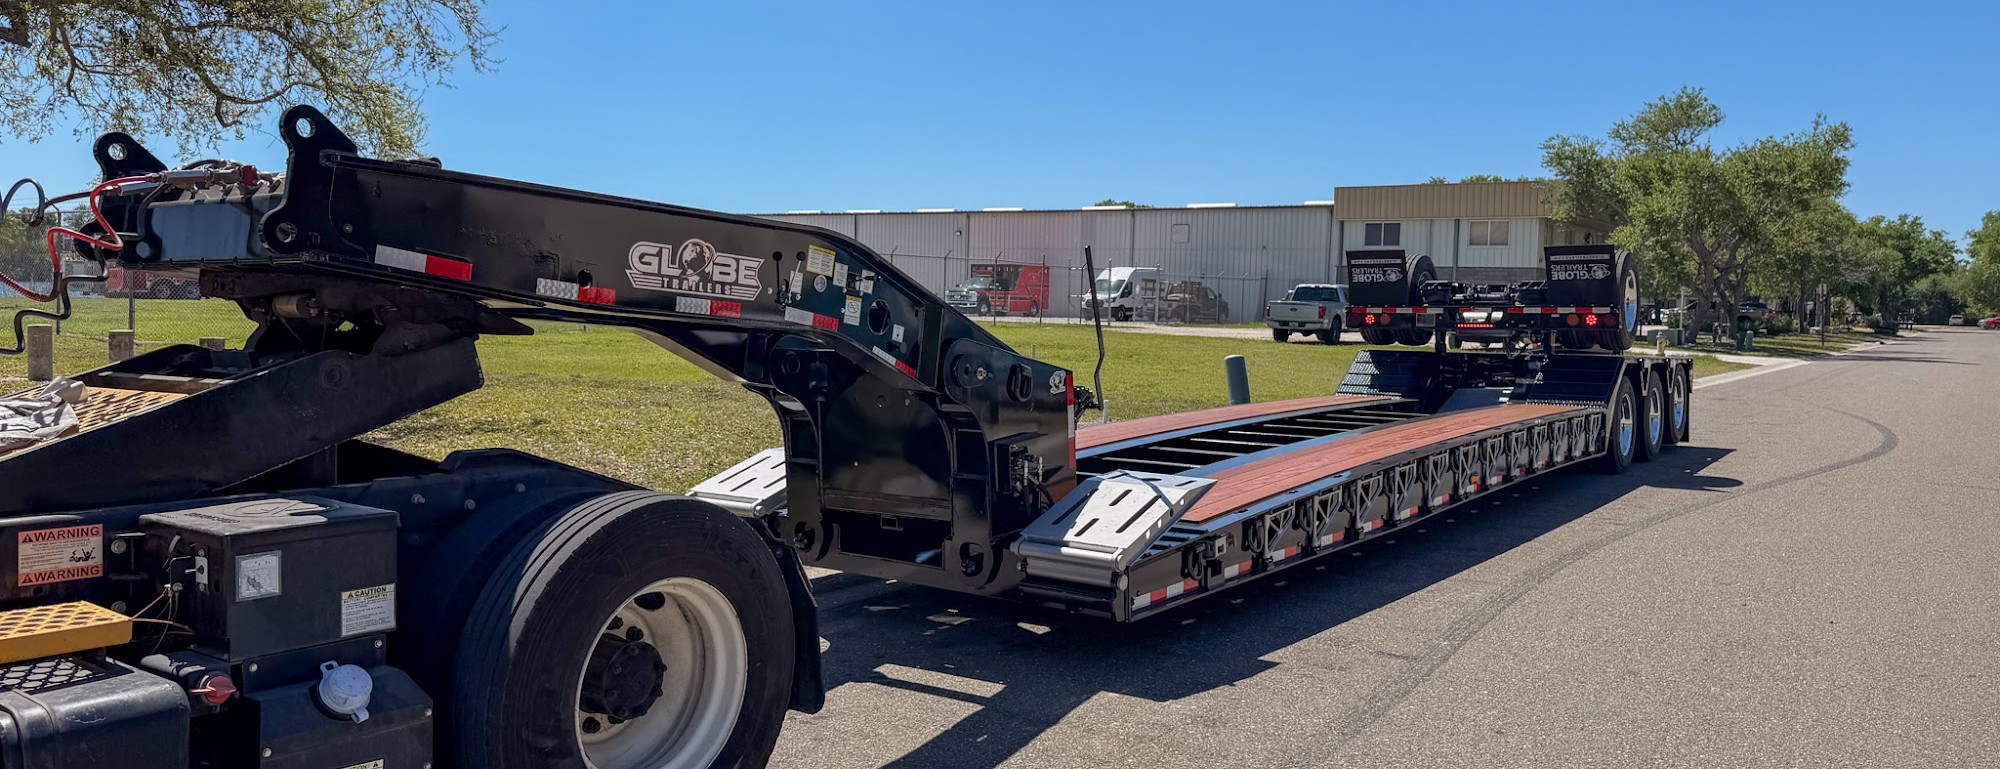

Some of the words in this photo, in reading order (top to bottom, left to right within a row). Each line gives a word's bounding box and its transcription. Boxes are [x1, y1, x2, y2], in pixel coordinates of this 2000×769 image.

[629, 238, 763, 287] GLOBE
[1351, 267, 1384, 275] TRAILERS
[1352, 273, 1384, 282] GLOBE
[1551, 270, 1589, 280] GLOBE
[662, 277, 732, 296] TRAILERS
[33, 526, 100, 542] WARNING
[33, 565, 100, 583] WARNING
[354, 586, 387, 597] CAUTION
